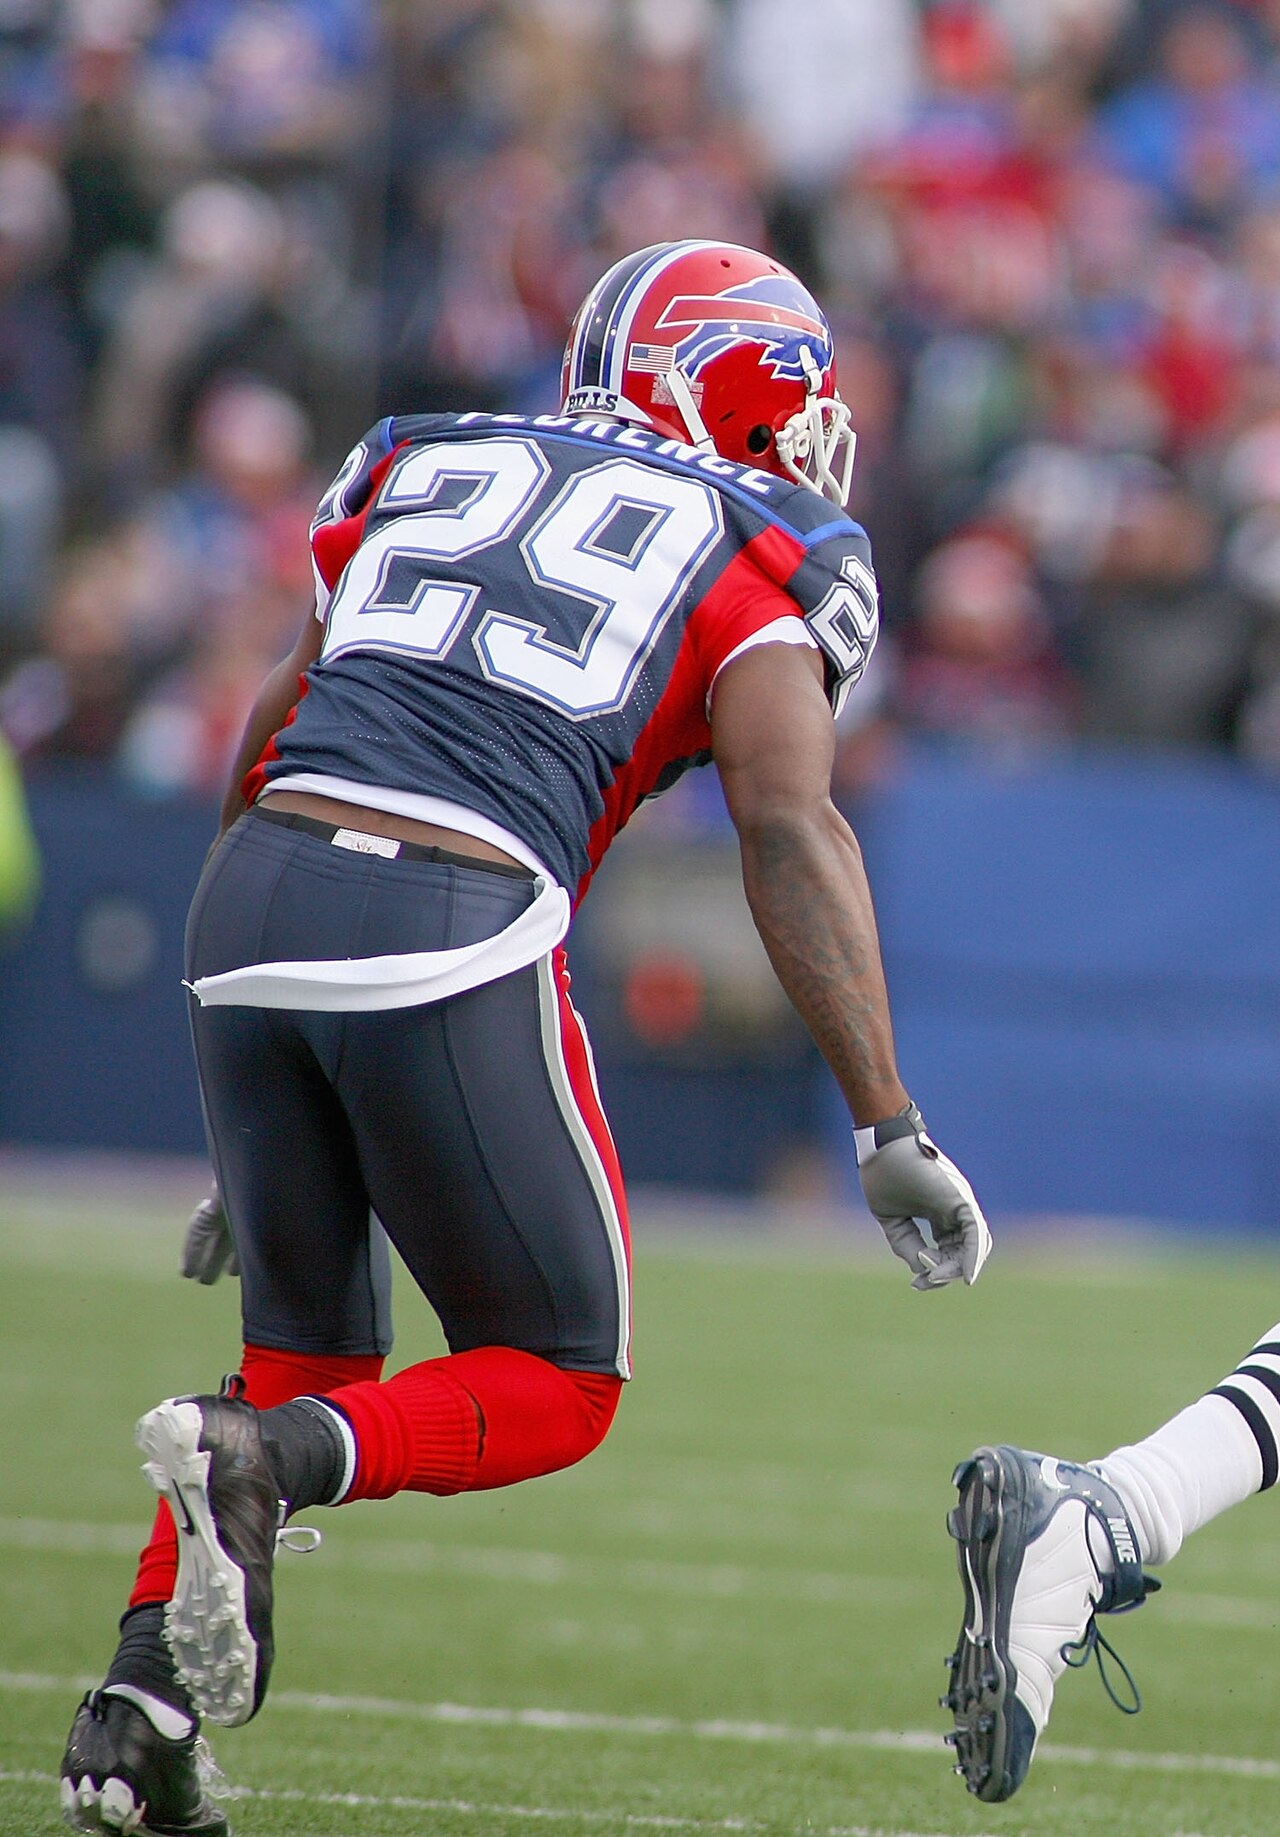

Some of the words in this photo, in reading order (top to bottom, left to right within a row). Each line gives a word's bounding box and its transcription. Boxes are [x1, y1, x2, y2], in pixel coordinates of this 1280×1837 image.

[566, 392, 619, 413] BILLS
[319, 436, 725, 721] 29
[1106, 1517, 1138, 1563] NIKE
